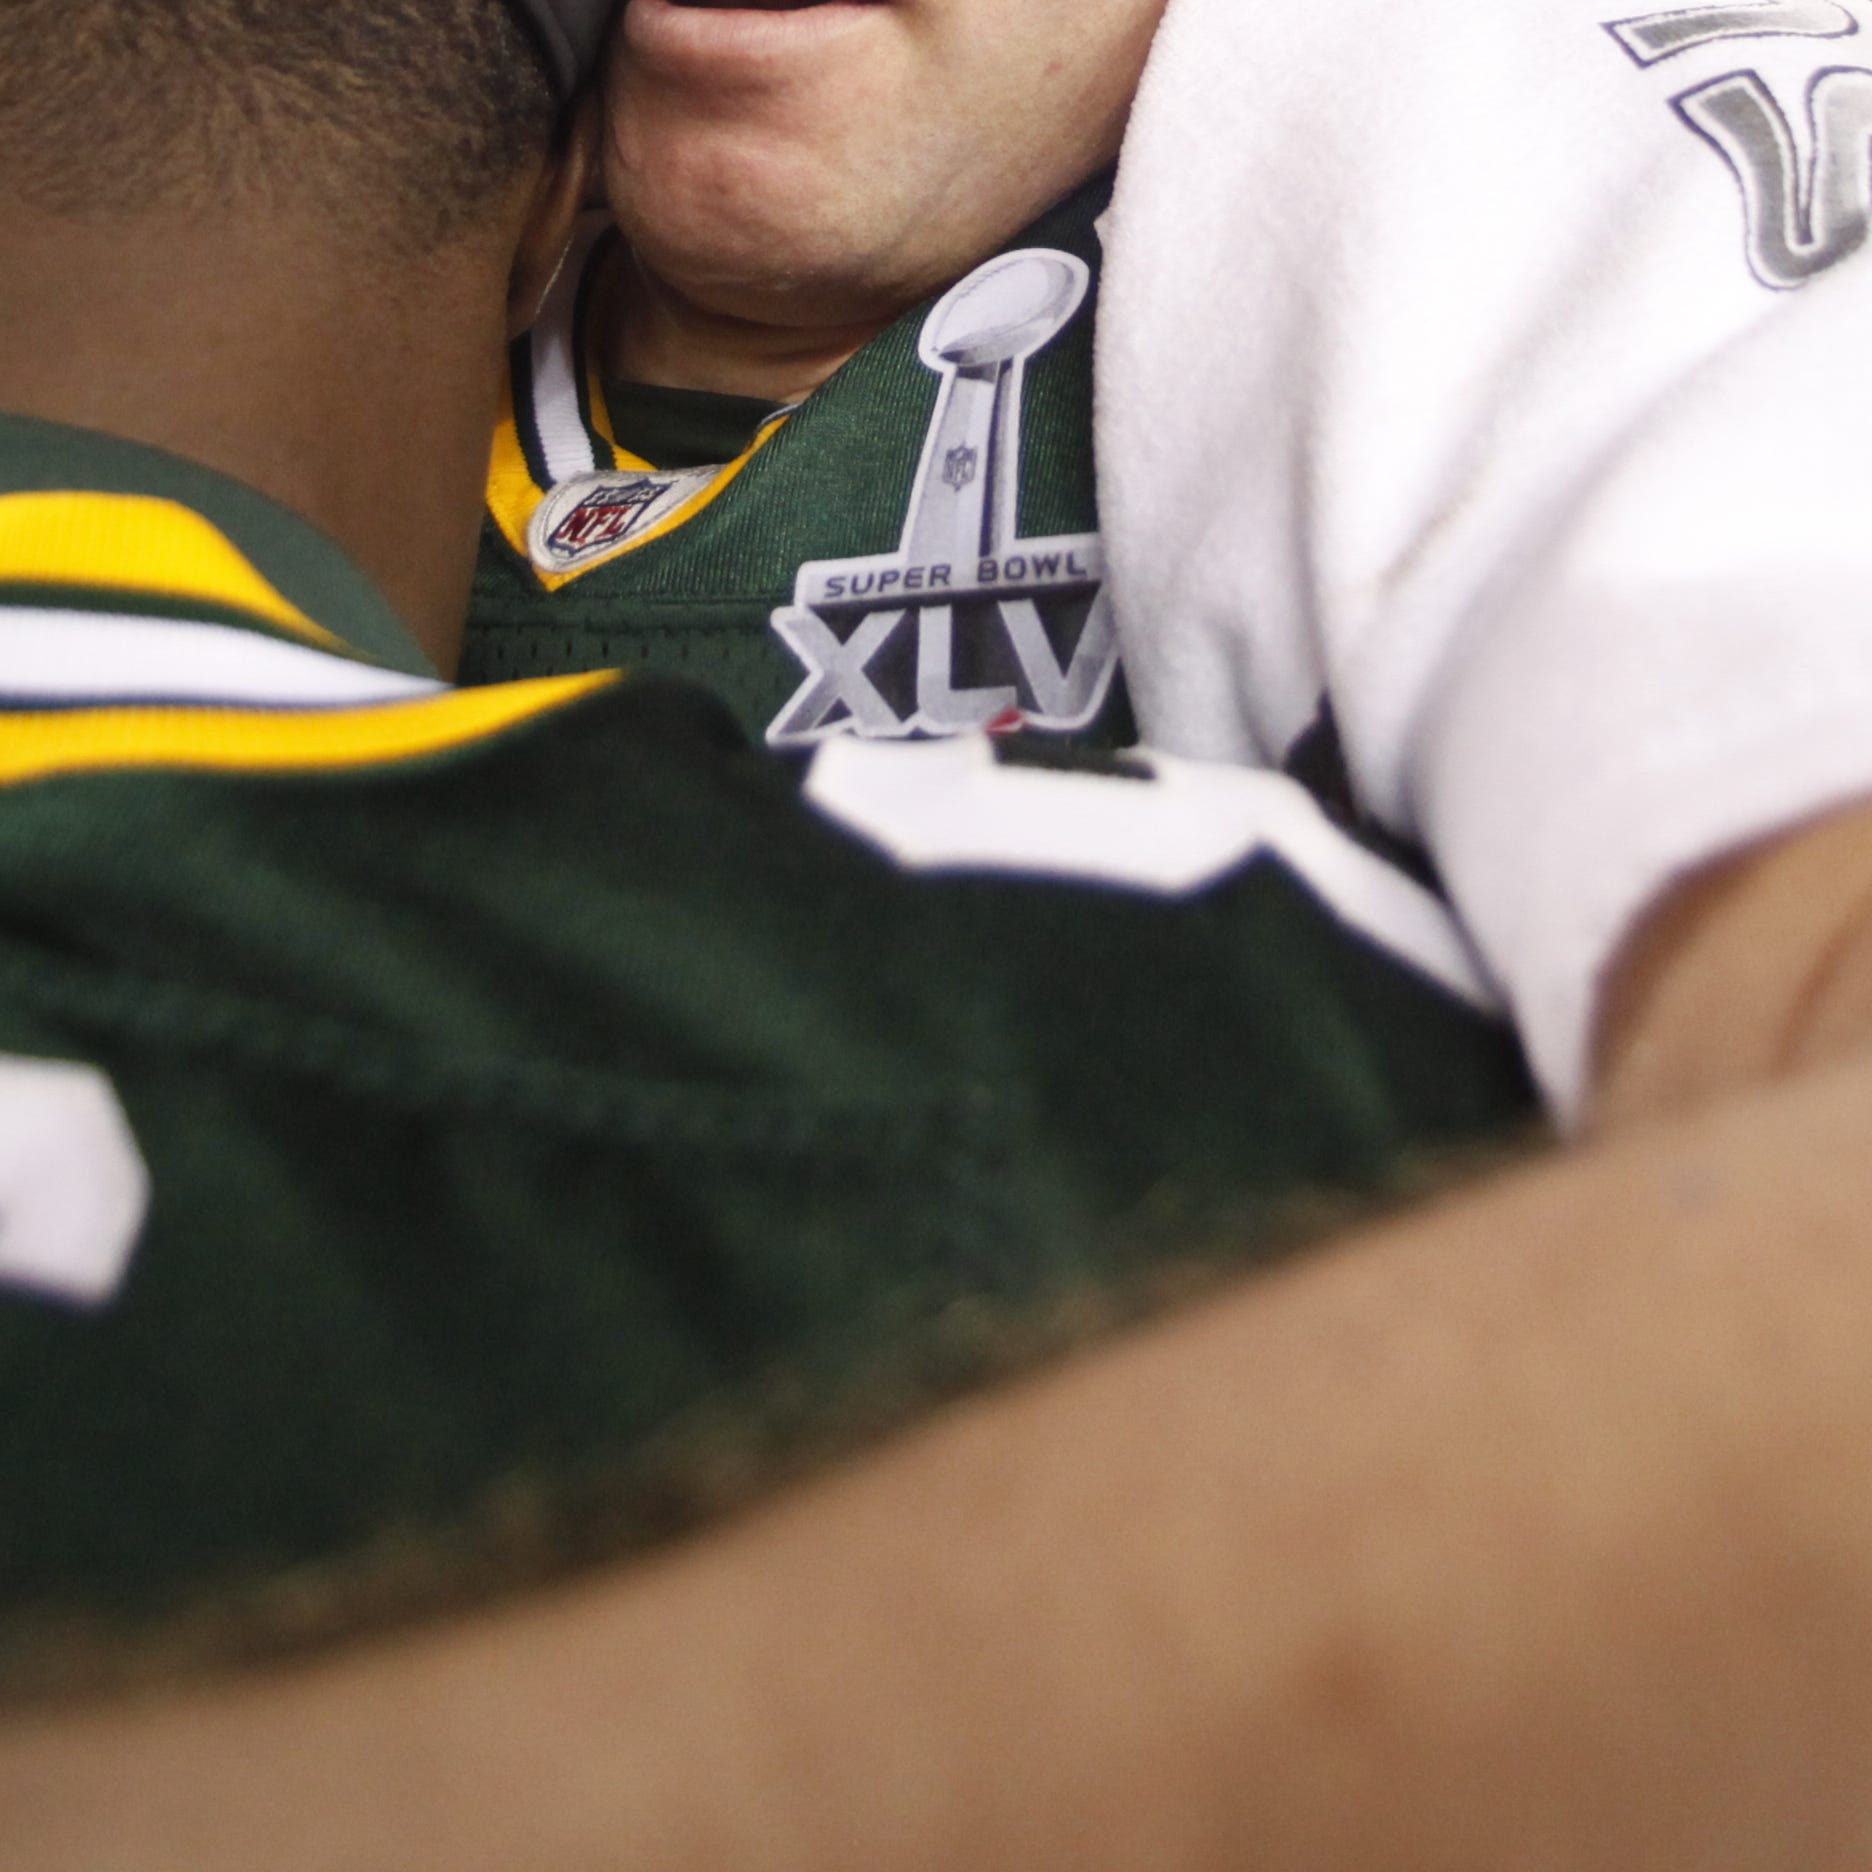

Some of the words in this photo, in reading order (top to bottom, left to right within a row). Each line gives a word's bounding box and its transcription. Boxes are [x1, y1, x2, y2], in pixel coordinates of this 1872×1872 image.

[555, 503, 634, 544] NFL
[824, 562, 953, 599] SUPER
[976, 552, 1088, 584] BOWL
[769, 584, 1120, 737] XLV
